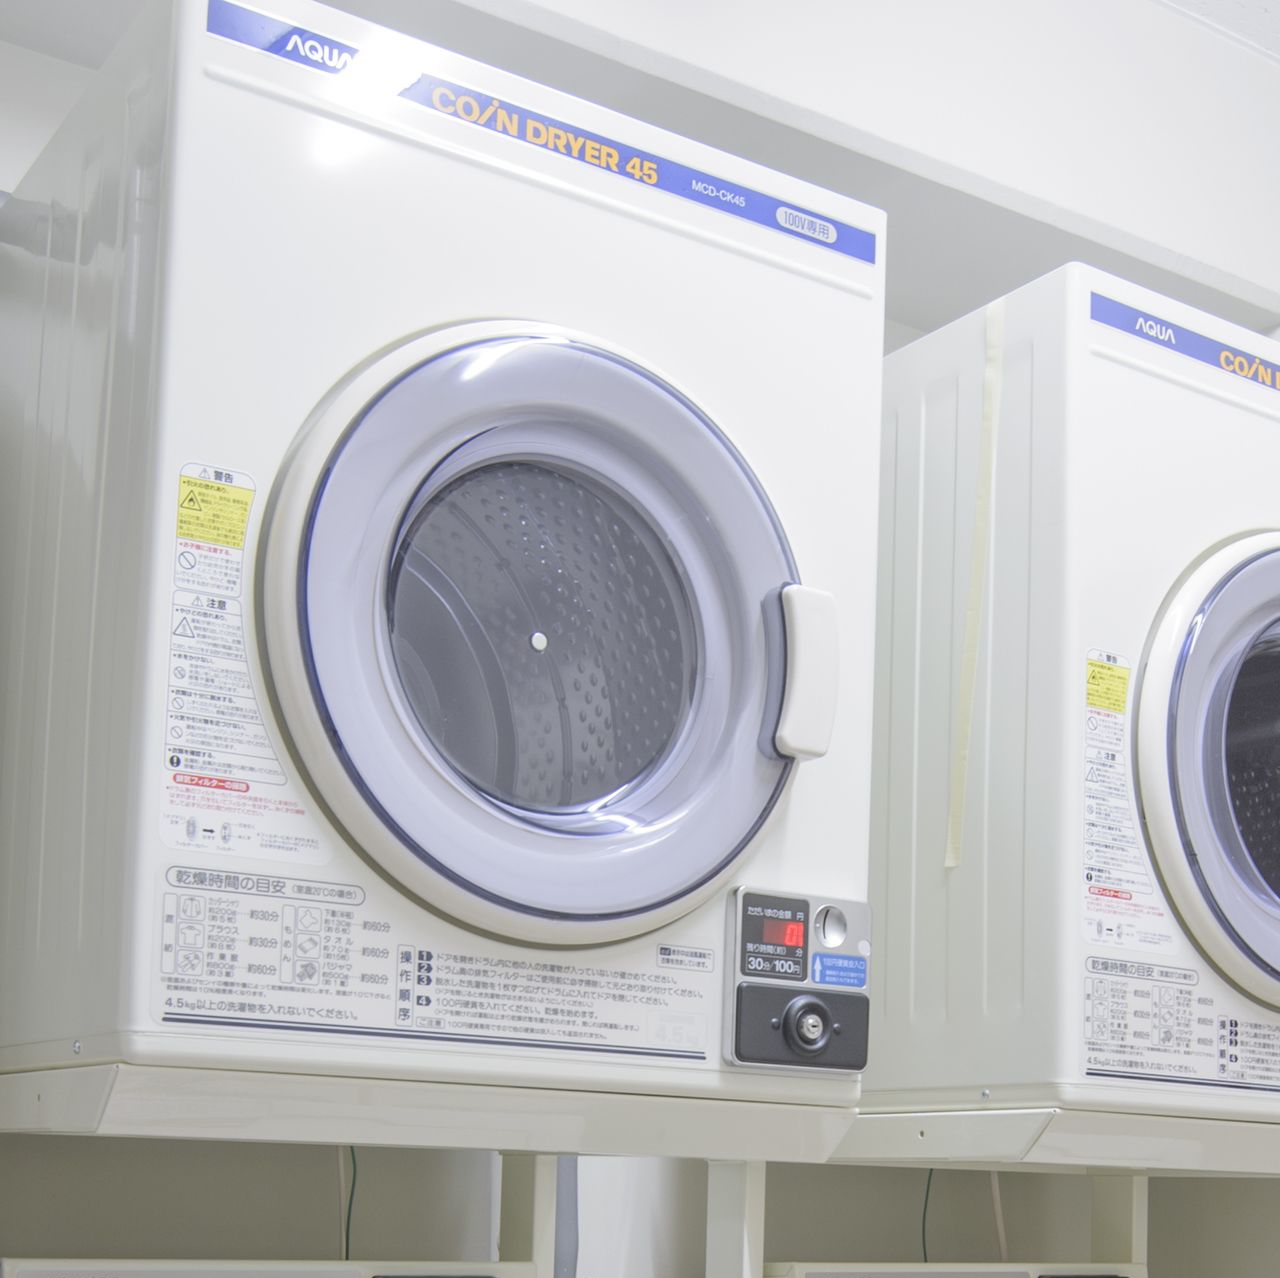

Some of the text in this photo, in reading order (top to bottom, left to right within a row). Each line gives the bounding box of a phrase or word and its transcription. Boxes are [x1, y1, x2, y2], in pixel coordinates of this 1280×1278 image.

[525, 119, 620, 173] DRYER
[625, 156, 659, 186] 45
[691, 179, 747, 208] MCD-CK45
[783, 210, 830, 240] 100V専用
[1135, 317, 1176, 345] AQUA
[213, 470, 234, 484] 警告
[206, 598, 227, 611] 注意
[176, 870, 287, 895] 乾燥時間の目安
[796, 911, 804, 921] 円
[207, 925, 240, 935] ブラウス
[795, 948, 803, 957] 分
[399, 950, 413, 1021] 操作順序
